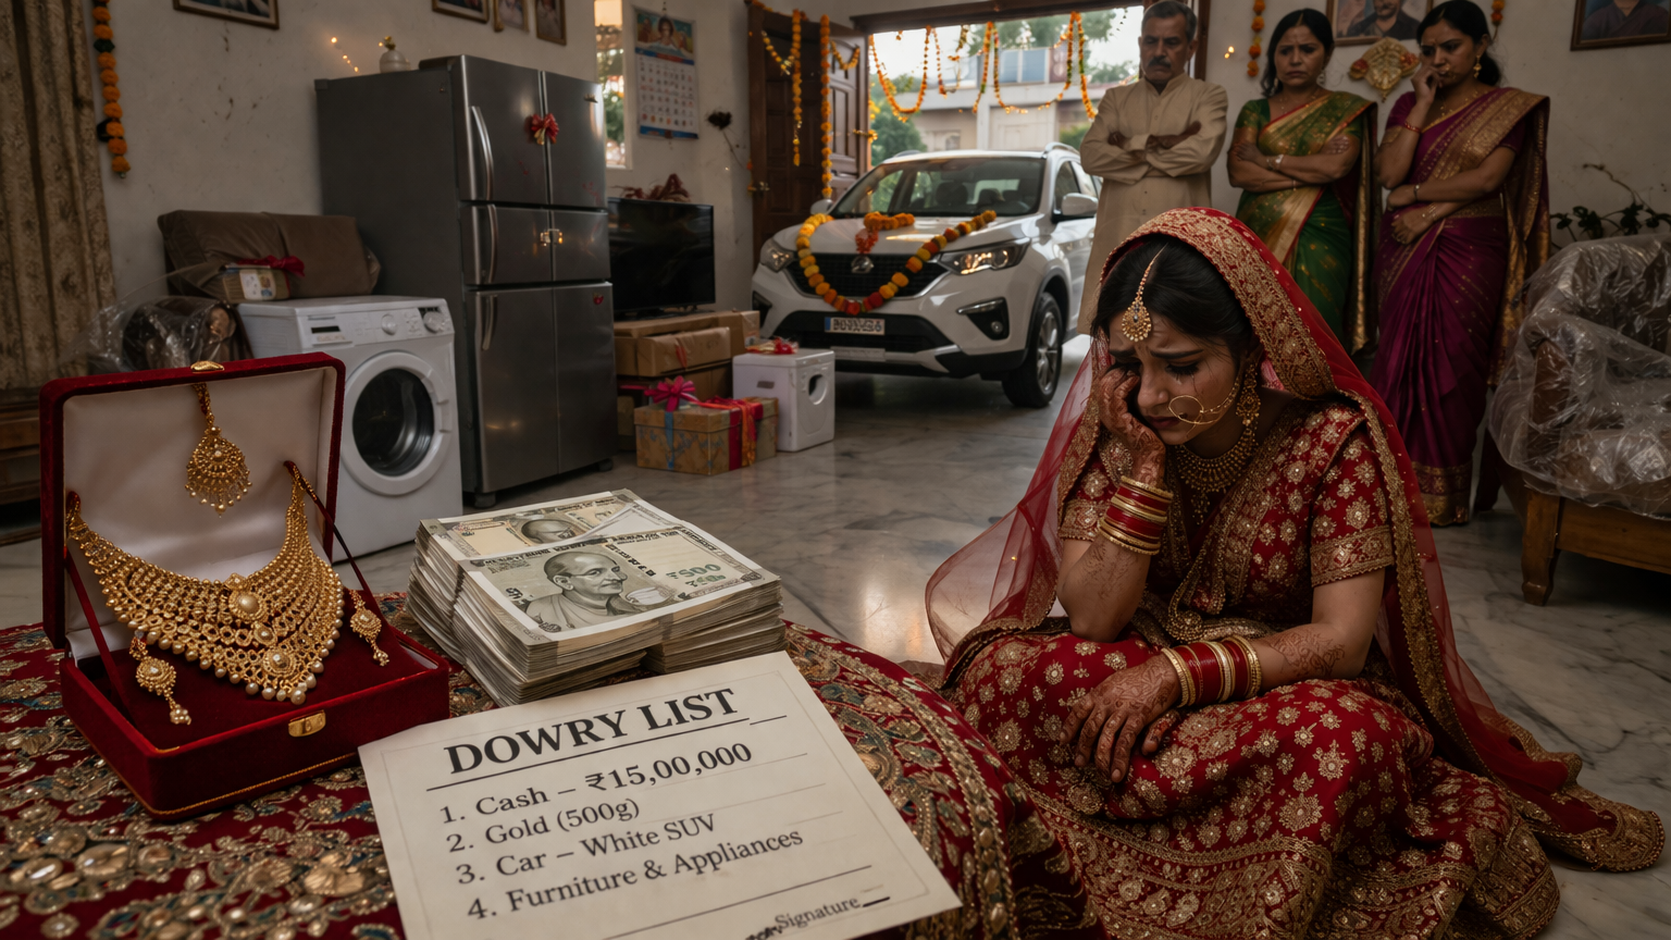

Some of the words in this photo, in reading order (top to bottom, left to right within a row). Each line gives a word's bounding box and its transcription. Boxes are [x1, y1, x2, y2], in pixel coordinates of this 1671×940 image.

[443, 709, 629, 775] DOWRY
[637, 687, 739, 731] LIST
[440, 805, 466, 824] 1.
[475, 786, 551, 816] Cash
[584, 742, 753, 792] ₹15,00,000
[446, 833, 476, 854] 2.
[484, 815, 551, 846] Gold
[556, 797, 641, 834] (500g)
[455, 863, 486, 886] 3.
[495, 851, 548, 878] Car
[579, 829, 661, 859] White
[663, 812, 716, 841] SUV
[466, 897, 498, 920] 4.
[505, 865, 638, 913] Furniture
[643, 859, 668, 880] &
[673, 829, 804, 876] Appliances
[774, 897, 862, 930] Signature
